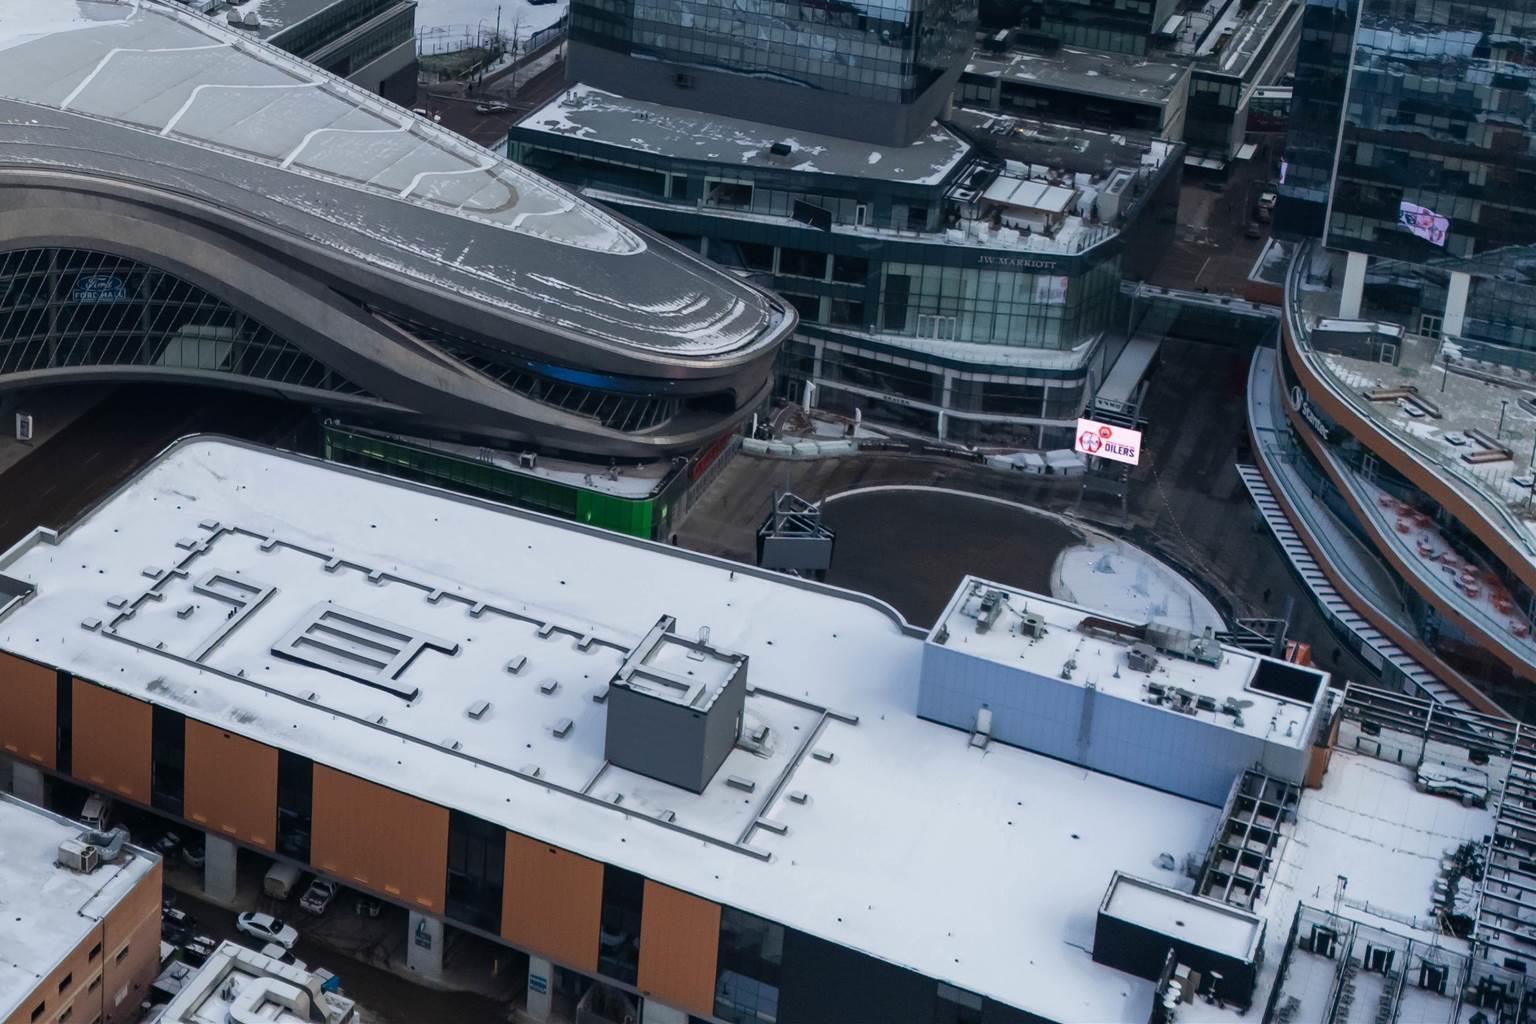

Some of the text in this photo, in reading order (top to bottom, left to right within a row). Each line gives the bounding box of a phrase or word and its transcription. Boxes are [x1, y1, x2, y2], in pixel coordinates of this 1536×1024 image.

[977, 255, 1057, 269] JW MARRIOTT
[1105, 443, 1135, 457] OILERS
